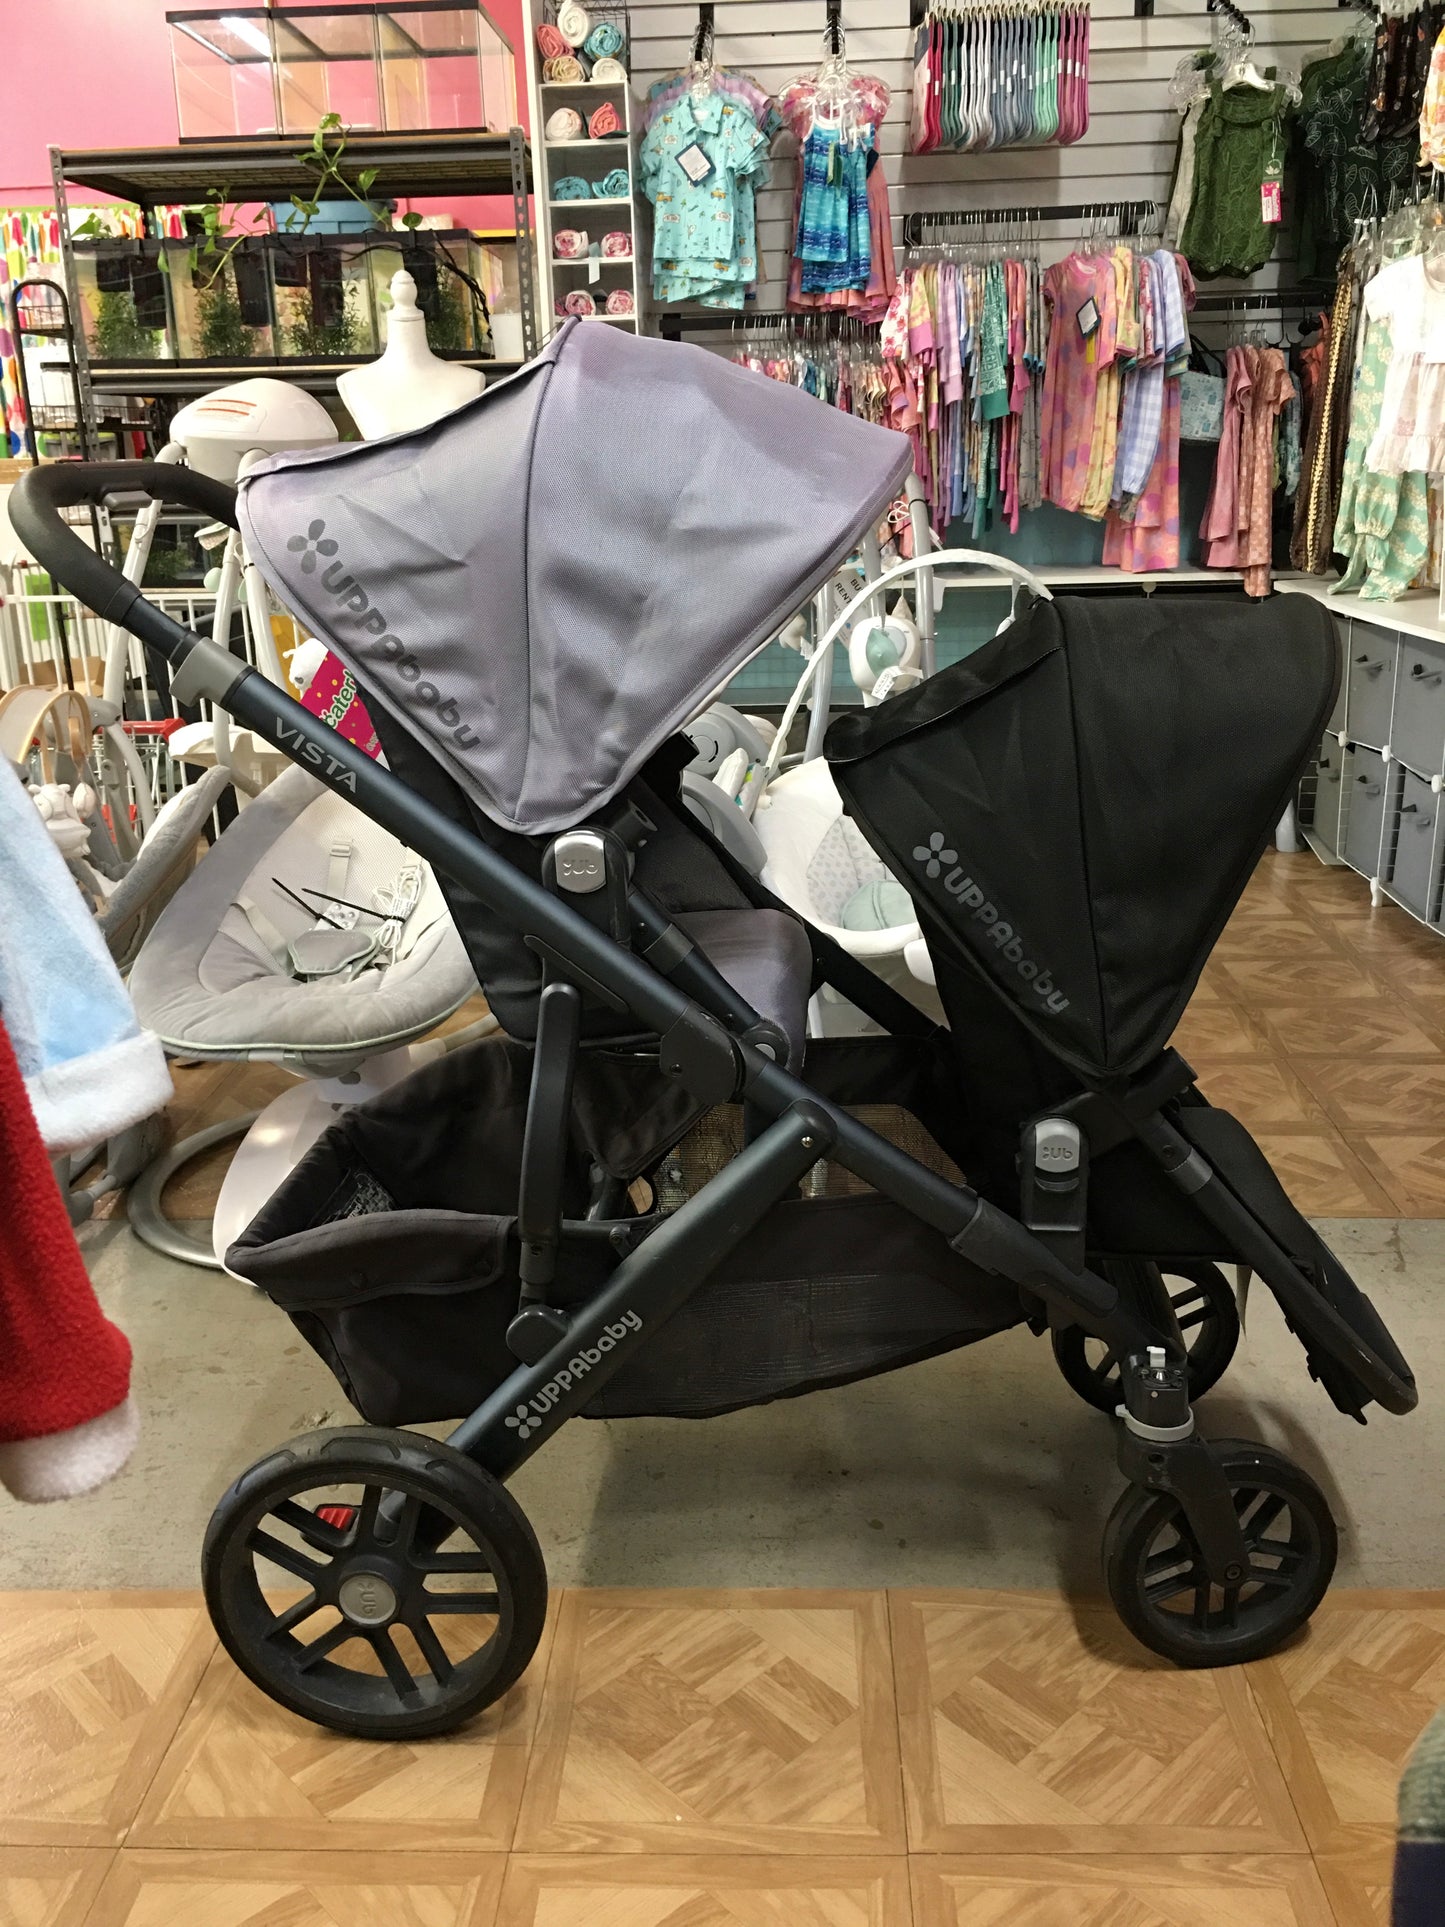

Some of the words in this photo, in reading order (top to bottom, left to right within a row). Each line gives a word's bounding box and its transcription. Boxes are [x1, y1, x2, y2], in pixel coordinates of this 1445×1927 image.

[850, 578, 864, 592] BU
[276, 716, 357, 794] VISTA
[943, 865, 1071, 1016] UPPAbaby
[528, 1309, 644, 1414] UPPAbaby
